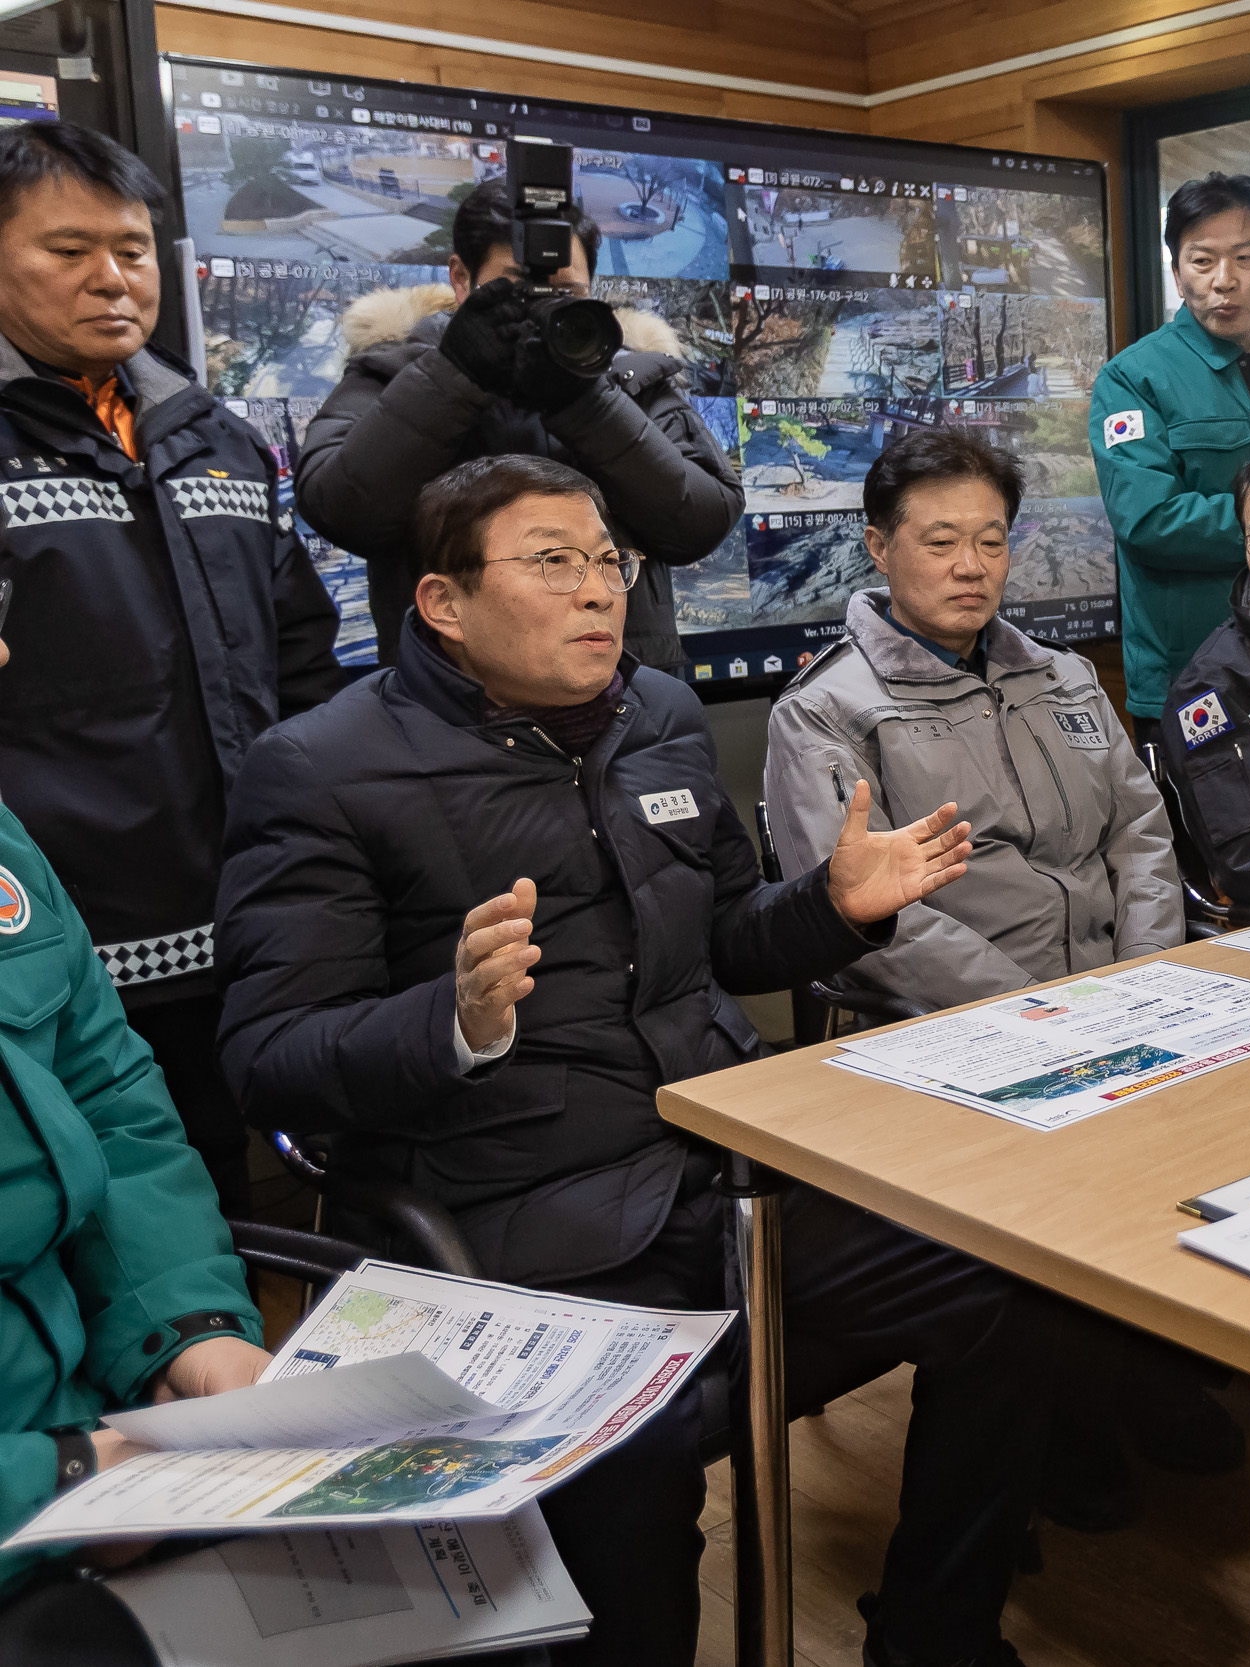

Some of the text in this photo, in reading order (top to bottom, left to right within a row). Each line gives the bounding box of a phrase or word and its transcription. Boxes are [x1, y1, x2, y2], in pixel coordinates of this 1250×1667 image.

[784, 516, 802, 528] [15]
[804, 628, 819, 637] Ver.
[1056, 712, 1095, 733] 경찰
[1068, 734, 1102, 745] POLICE
[1192, 725, 1226, 746] KOREA
